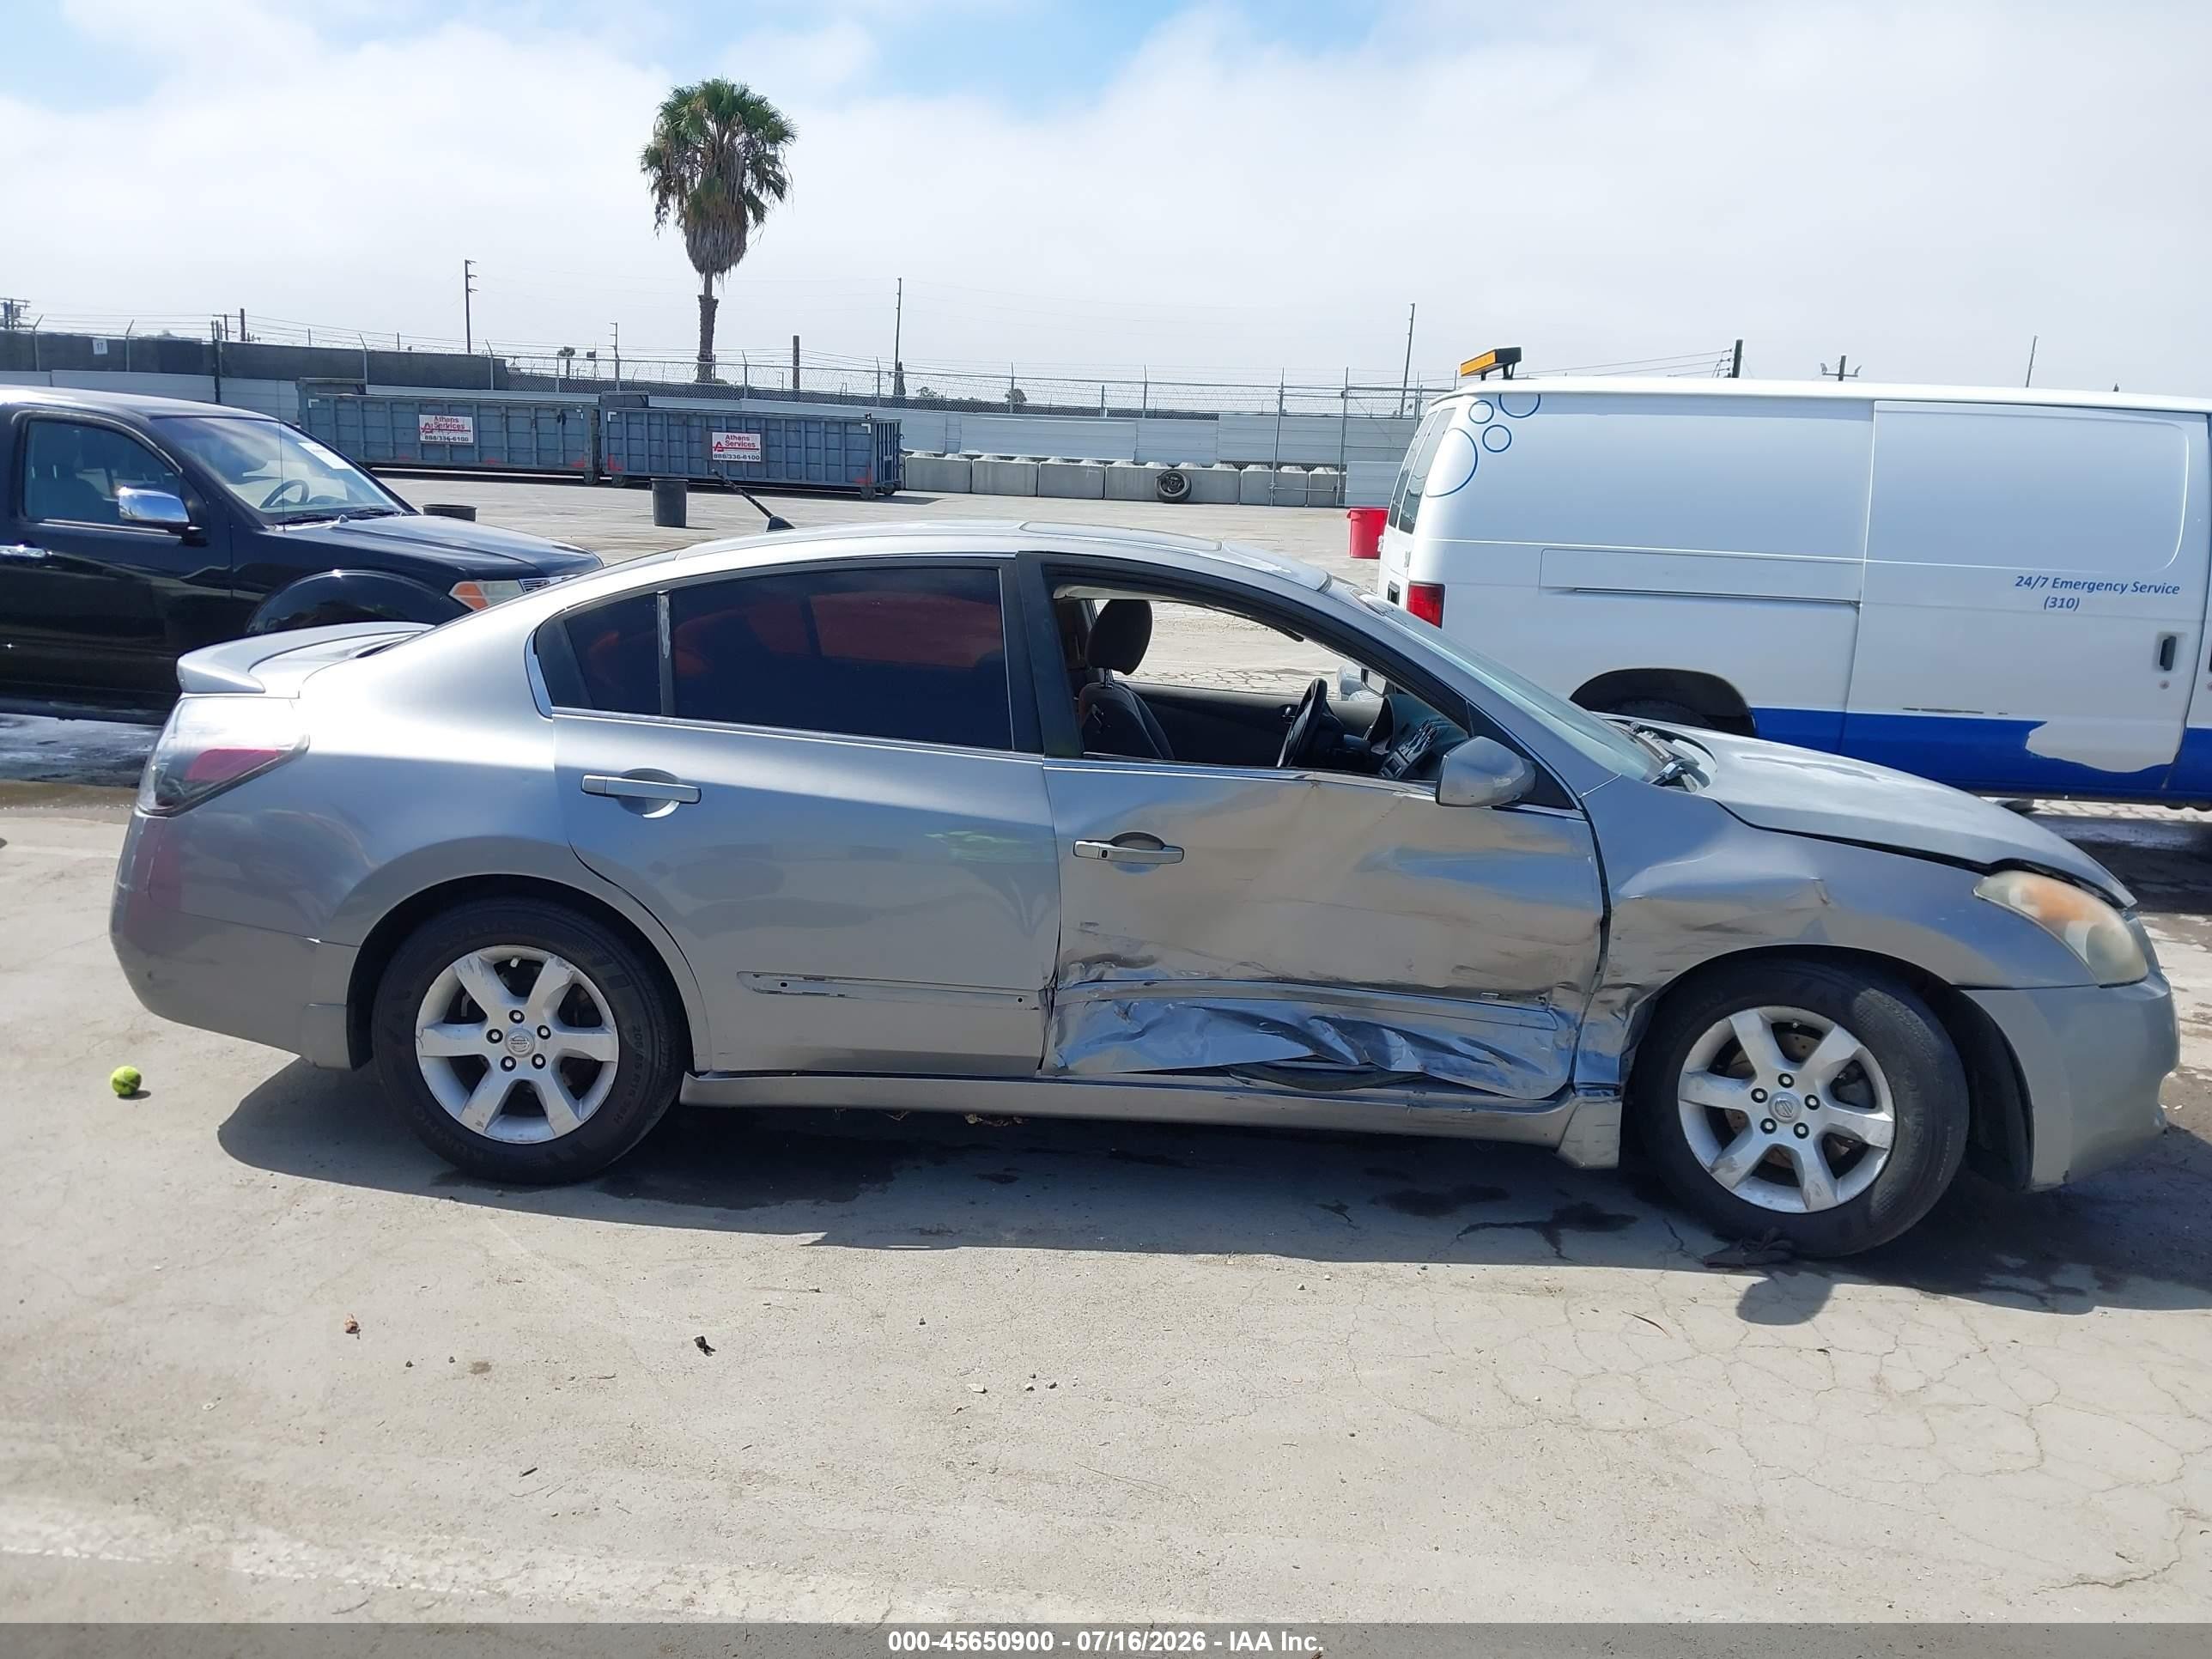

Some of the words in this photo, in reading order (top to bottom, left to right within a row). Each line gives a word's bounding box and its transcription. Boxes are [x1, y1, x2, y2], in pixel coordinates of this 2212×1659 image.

[2014, 575, 2049, 590] 24/7
[2051, 577, 2129, 594] Emergency
[2130, 581, 2180, 594] Service
[2044, 596, 2080, 611] (310)
